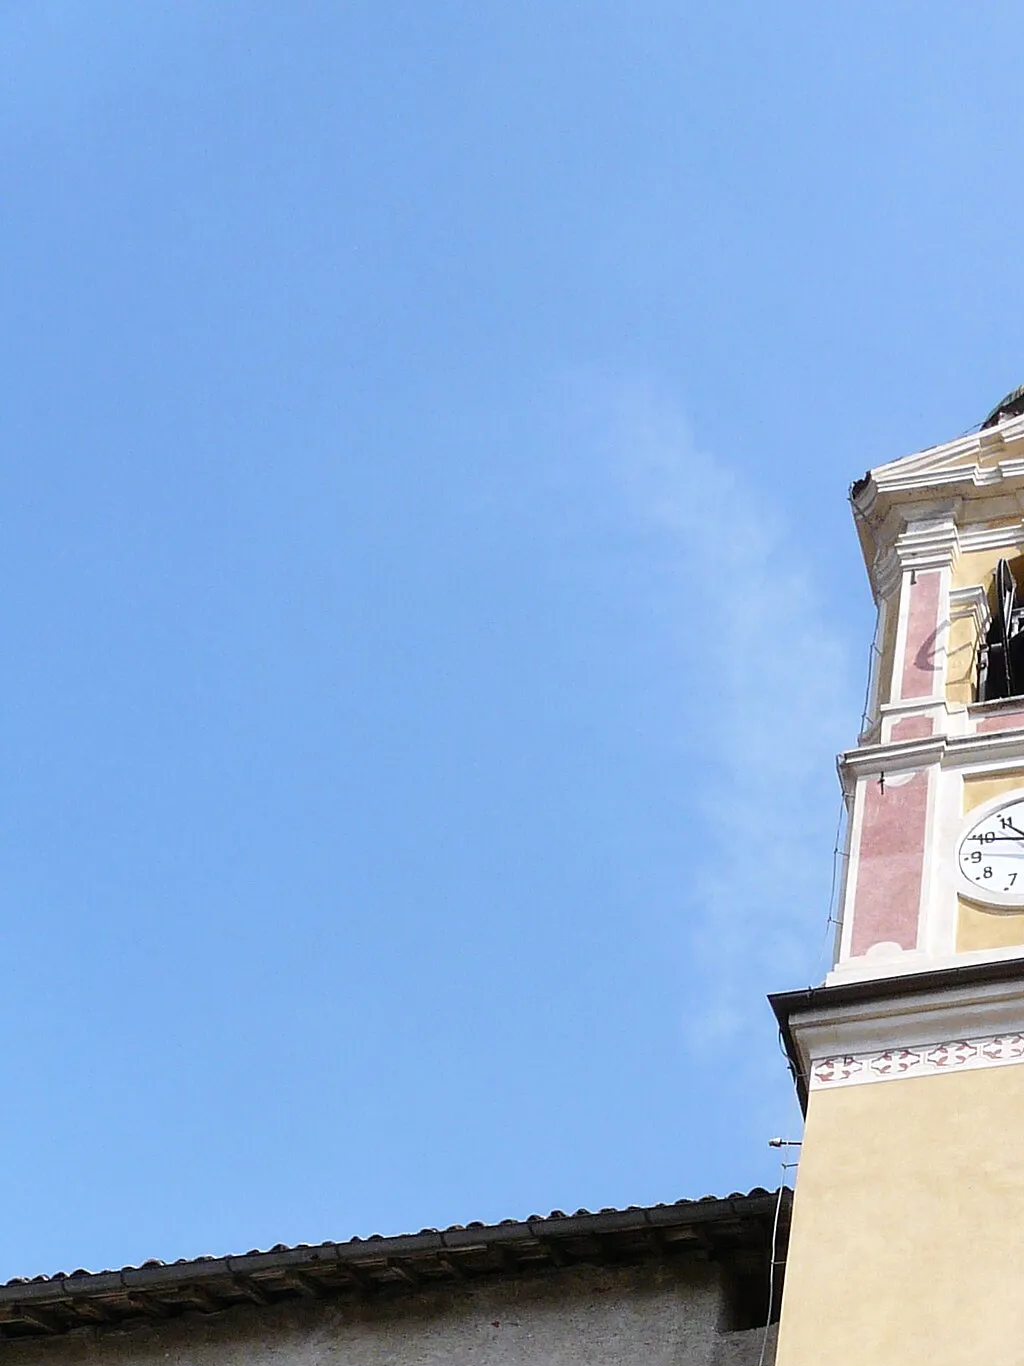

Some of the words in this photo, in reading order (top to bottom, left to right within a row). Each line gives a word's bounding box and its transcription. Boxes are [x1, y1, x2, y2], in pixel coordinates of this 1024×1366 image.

[1000, 817, 1012, 829] 11
[978, 832, 995, 845] 10
[971, 851, 982, 863] 9
[983, 867, 992, 878] 8
[1008, 873, 1017, 886] 7
